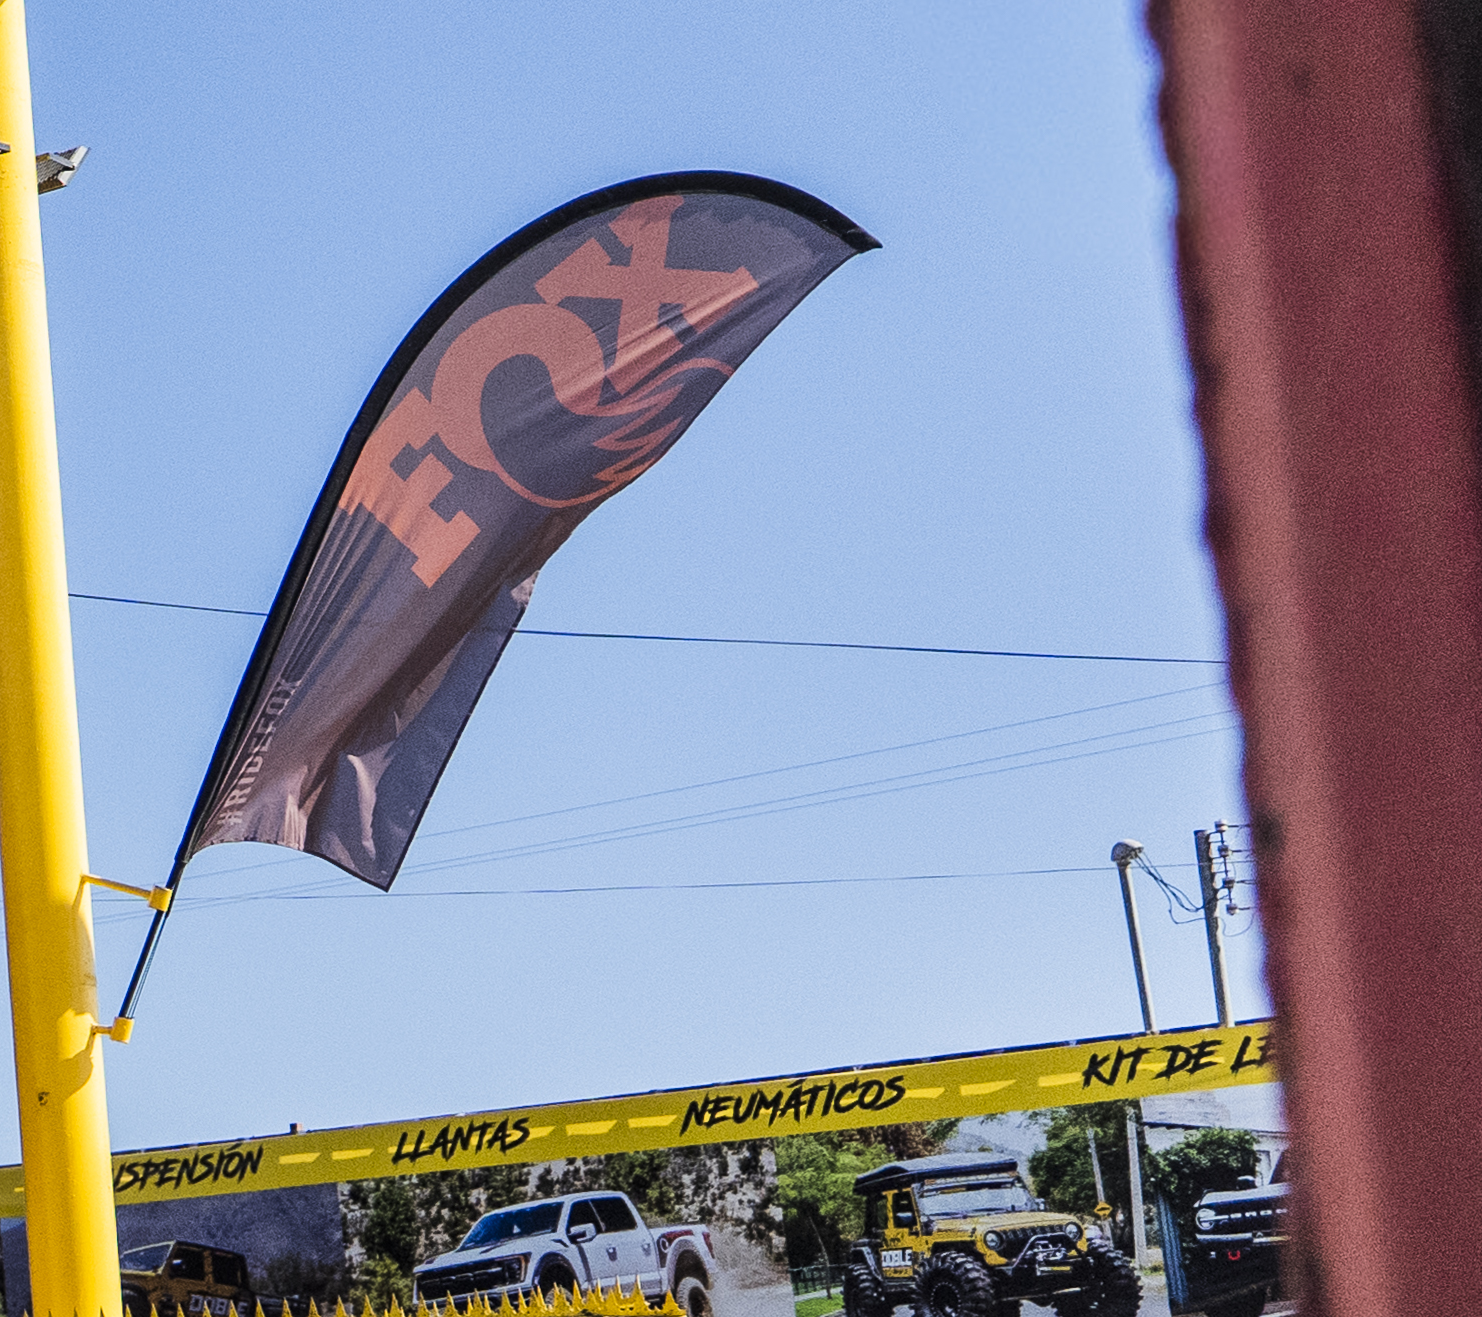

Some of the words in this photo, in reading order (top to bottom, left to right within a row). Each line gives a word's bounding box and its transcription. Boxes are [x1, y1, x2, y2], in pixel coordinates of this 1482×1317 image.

[338, 193, 760, 591] FOX
[1082, 1044, 1156, 1090] KIT
[1154, 1038, 1224, 1081] DE
[679, 1075, 907, 1138] NEUMÁTICOS
[391, 1115, 531, 1166] LLANTAS
